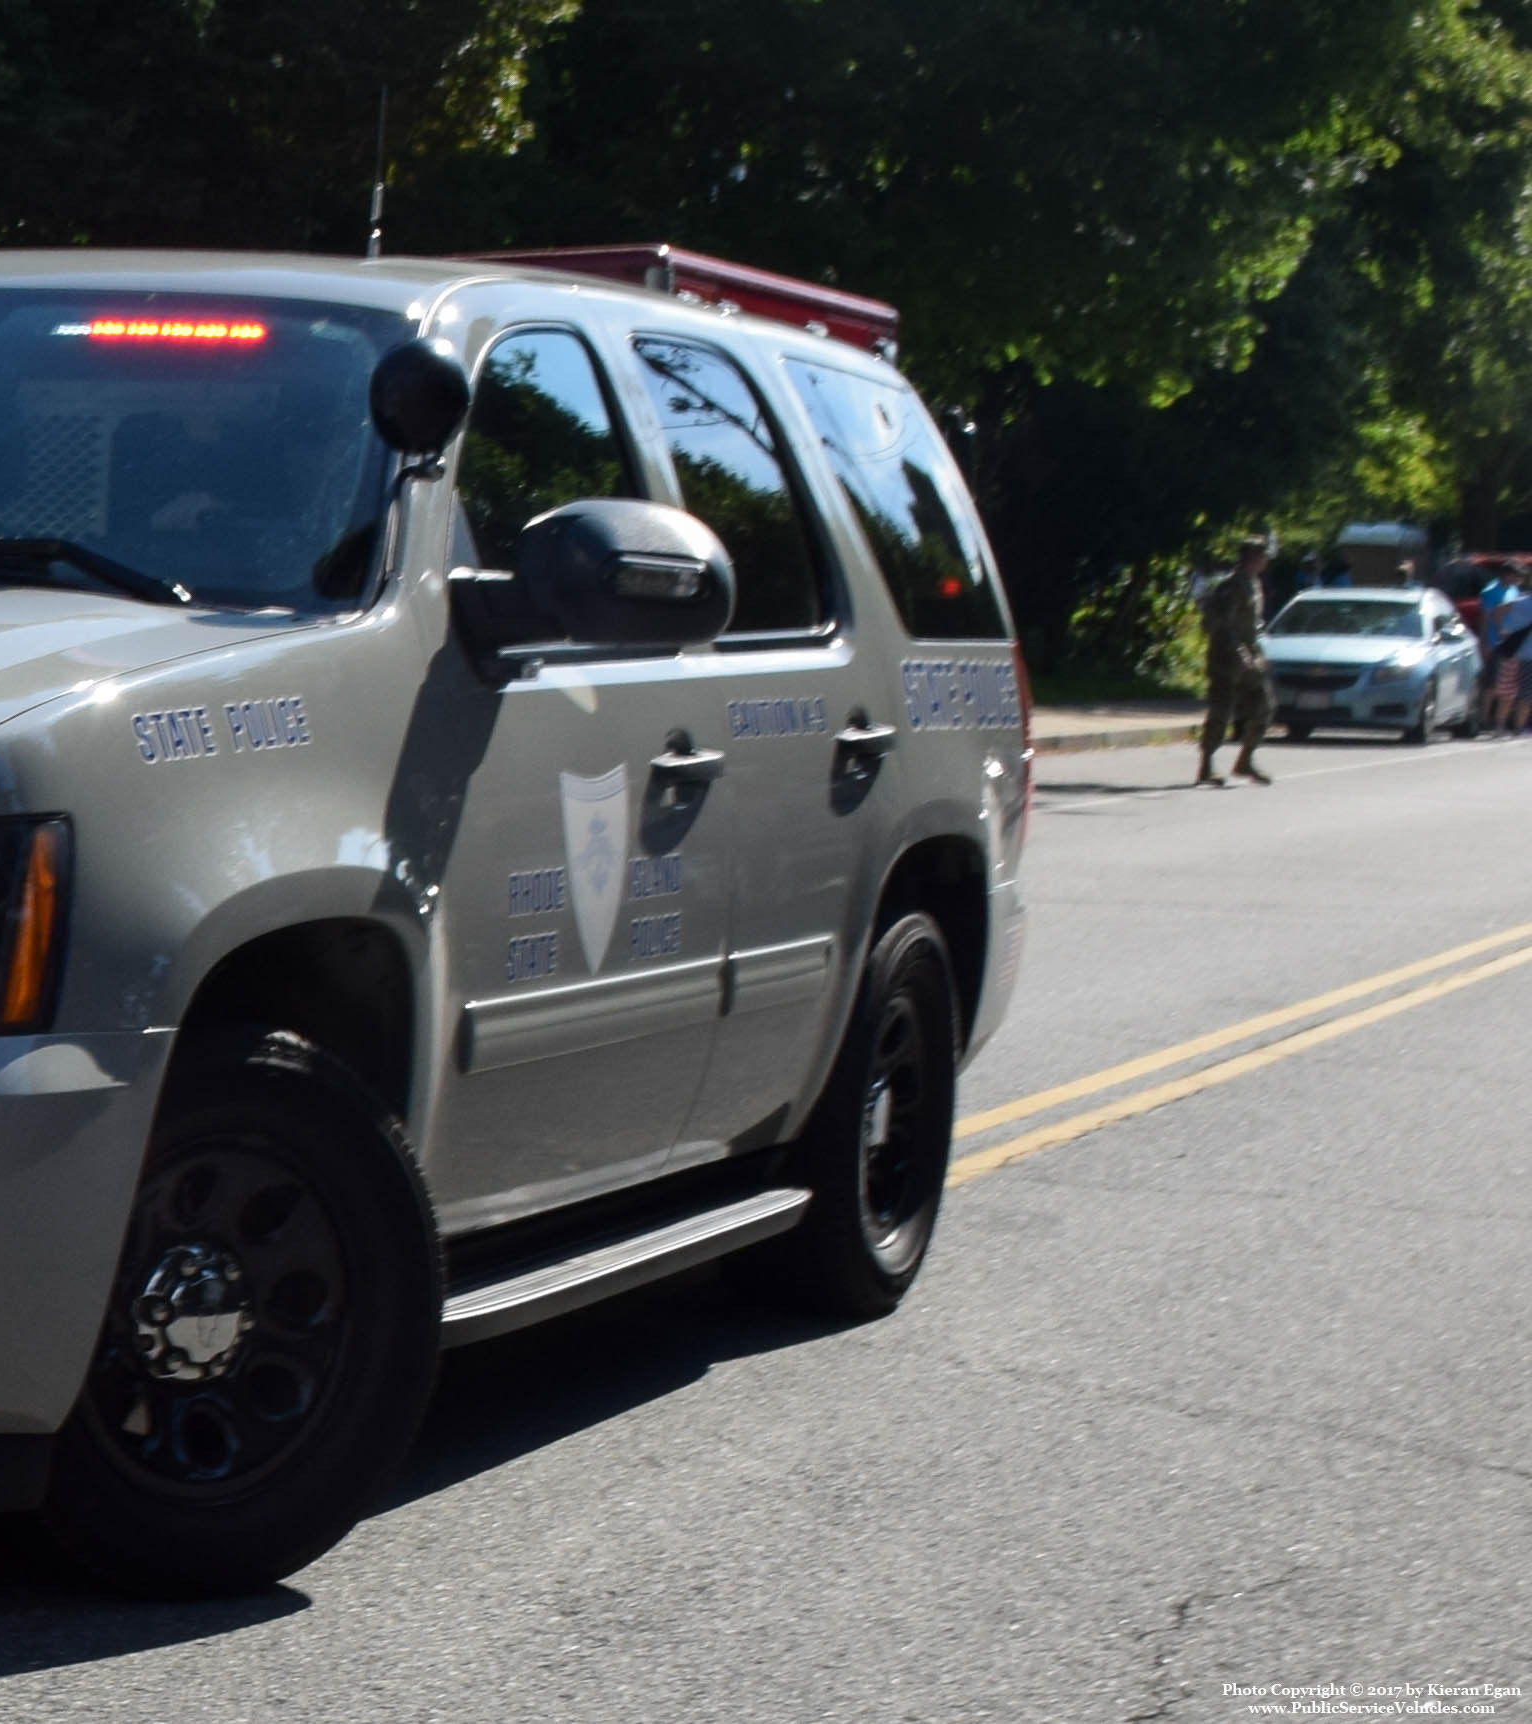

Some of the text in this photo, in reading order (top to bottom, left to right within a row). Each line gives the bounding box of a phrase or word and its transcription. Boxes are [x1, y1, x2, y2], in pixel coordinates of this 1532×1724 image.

[131, 696, 311, 764] STATE POLICE
[900, 658, 1020, 732] STATE POLICE
[508, 867, 565, 918] RHODE
[506, 910, 682, 983] STATE POLICE
